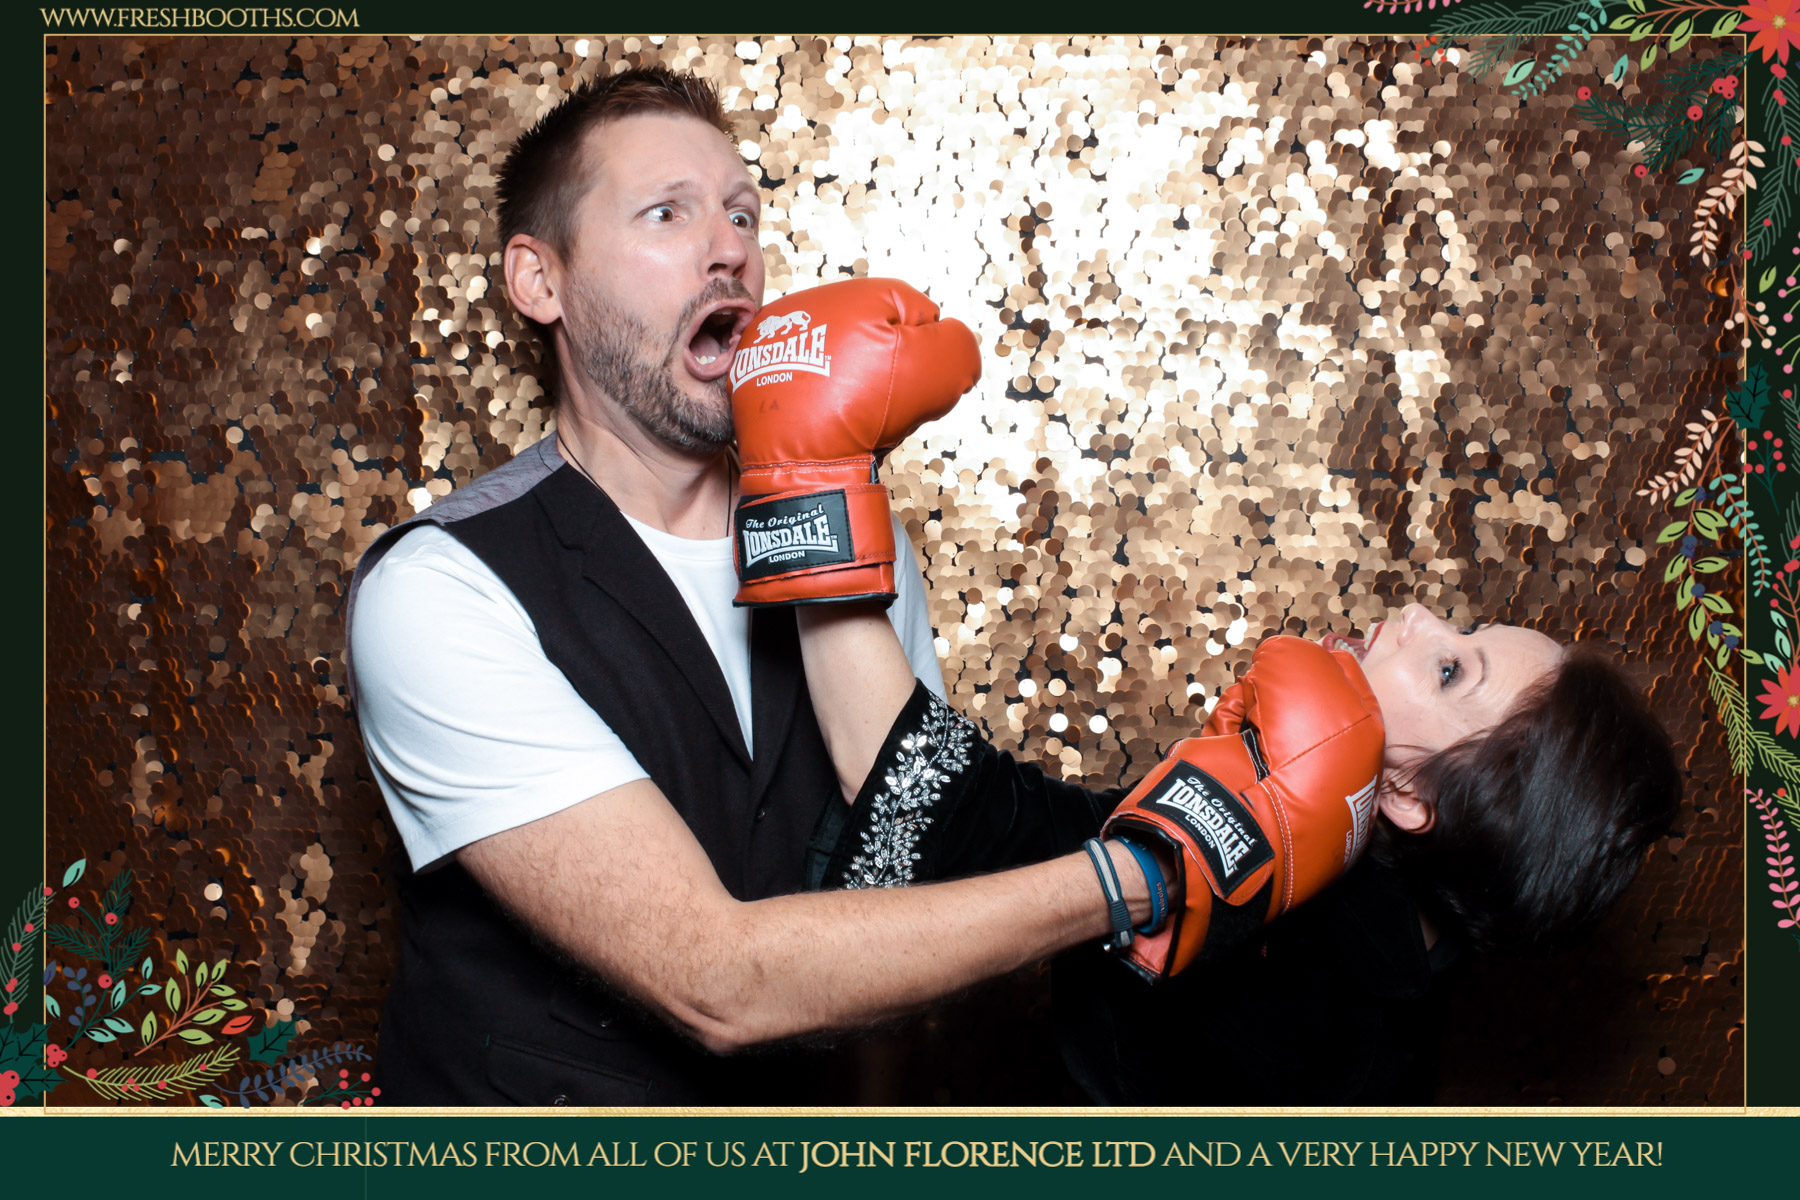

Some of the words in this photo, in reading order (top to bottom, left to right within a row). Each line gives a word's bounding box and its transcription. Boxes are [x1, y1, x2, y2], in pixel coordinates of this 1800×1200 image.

[729, 323, 831, 390] LONSDALE
[756, 372, 793, 387] LONDON
[746, 519, 764, 529] The
[767, 503, 824, 528] Original
[742, 514, 839, 568] LONSDALE
[768, 550, 806, 563] LONDON
[1156, 778, 1252, 879] LONSDALE
[1184, 814, 1216, 849] LONDON
[1186, 775, 1210, 797] The
[1210, 797, 1258, 847] Original
